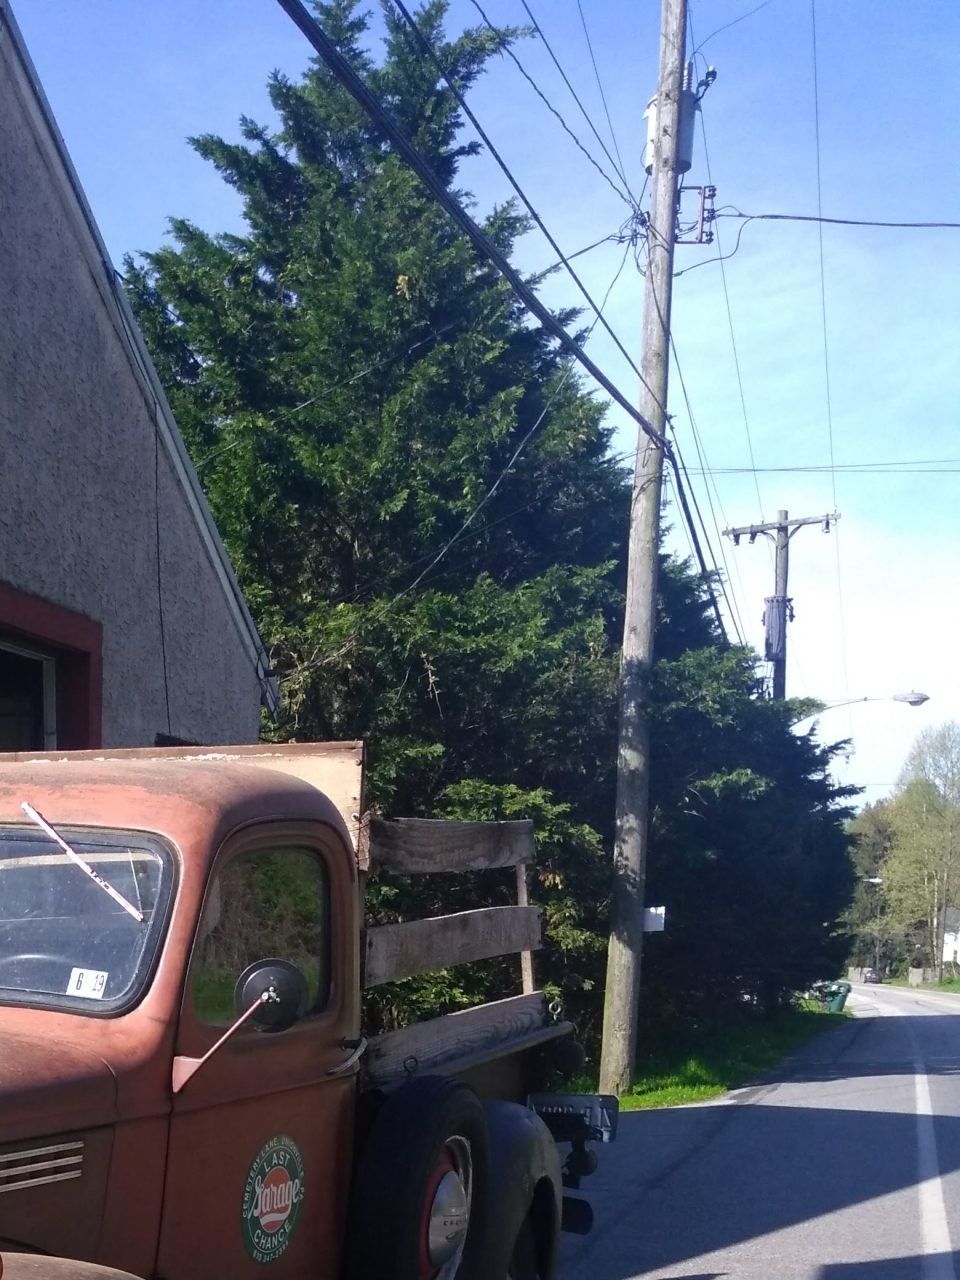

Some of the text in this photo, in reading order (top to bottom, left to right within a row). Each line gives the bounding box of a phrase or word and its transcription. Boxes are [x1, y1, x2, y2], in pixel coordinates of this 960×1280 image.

[76, 973, 105, 991] 6 19
[263, 1151, 290, 1173] LAST
[248, 1175, 300, 1219] Garage
[254, 1220, 291, 1252] CHANCE
